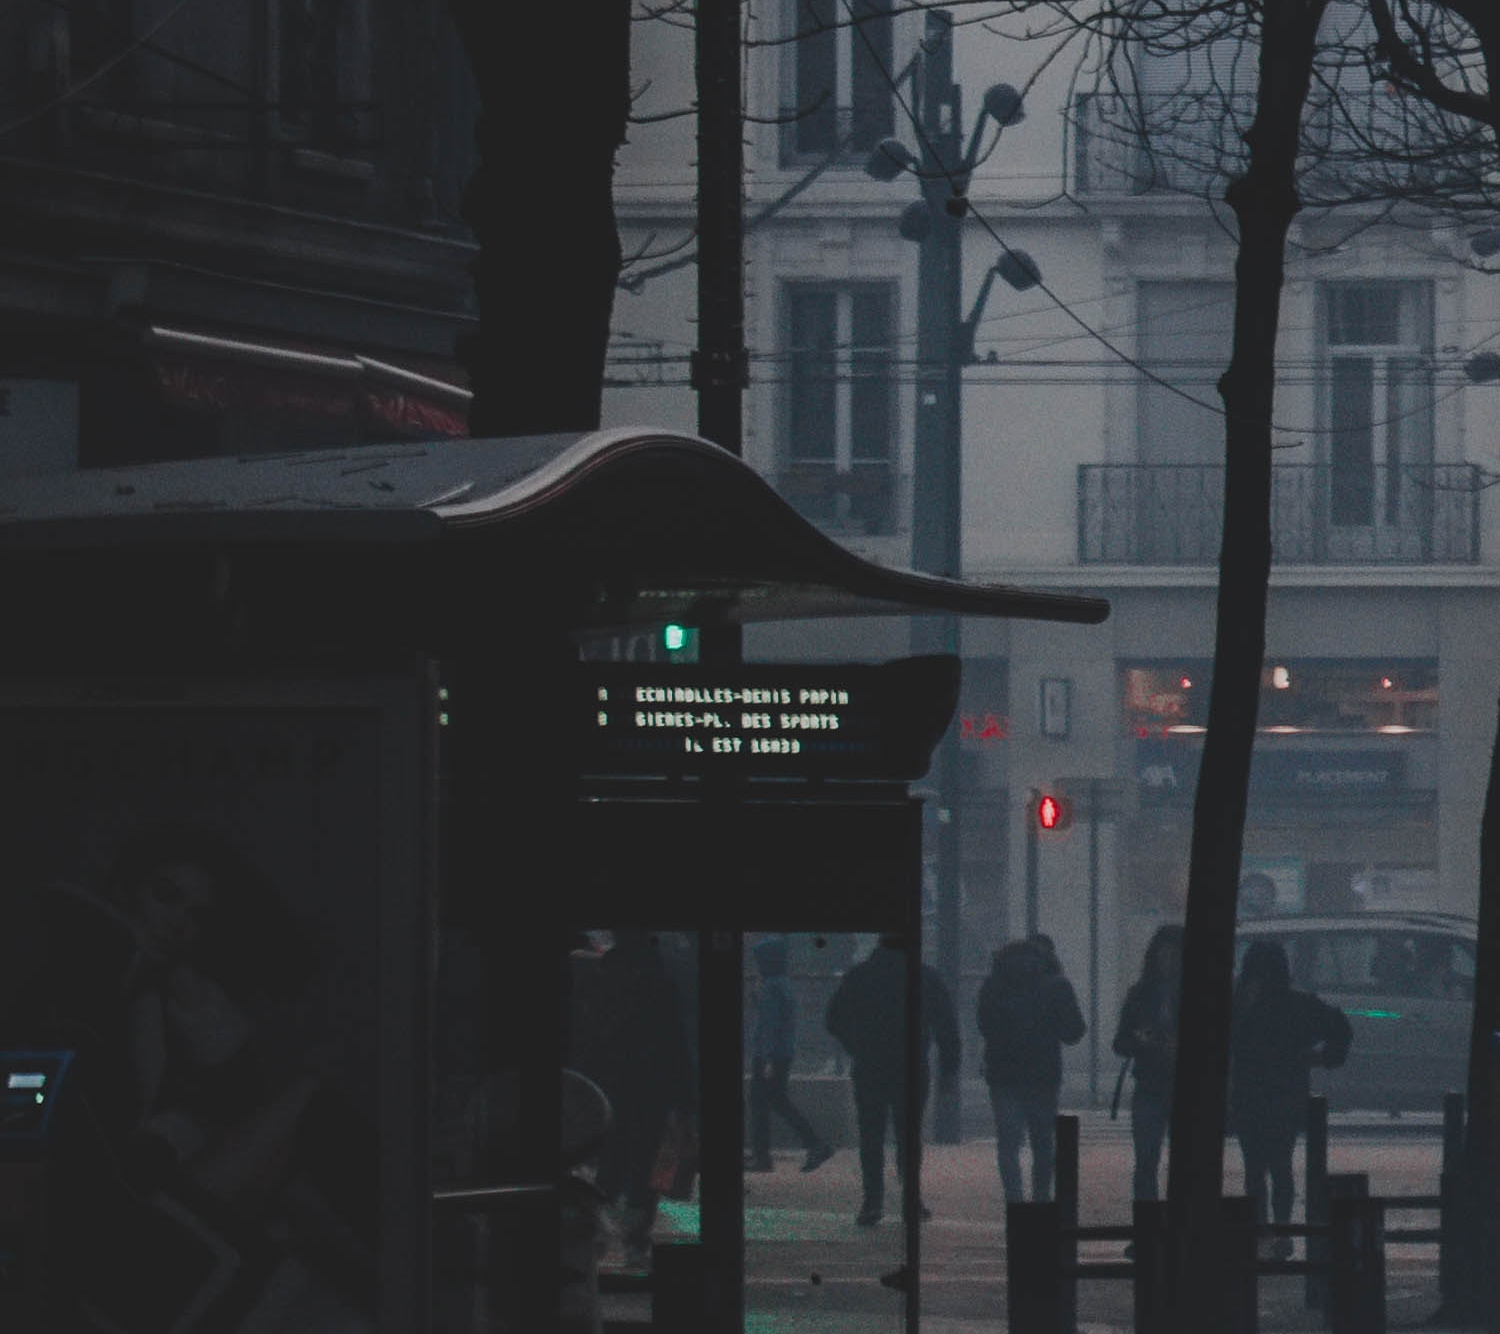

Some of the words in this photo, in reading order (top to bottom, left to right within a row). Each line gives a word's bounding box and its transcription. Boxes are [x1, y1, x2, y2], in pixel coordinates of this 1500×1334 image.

[799, 688, 849, 704] PAPIN
[741, 712, 772, 729] DES
[780, 712, 840, 729] SPORTS
[712, 737, 742, 753] EST
